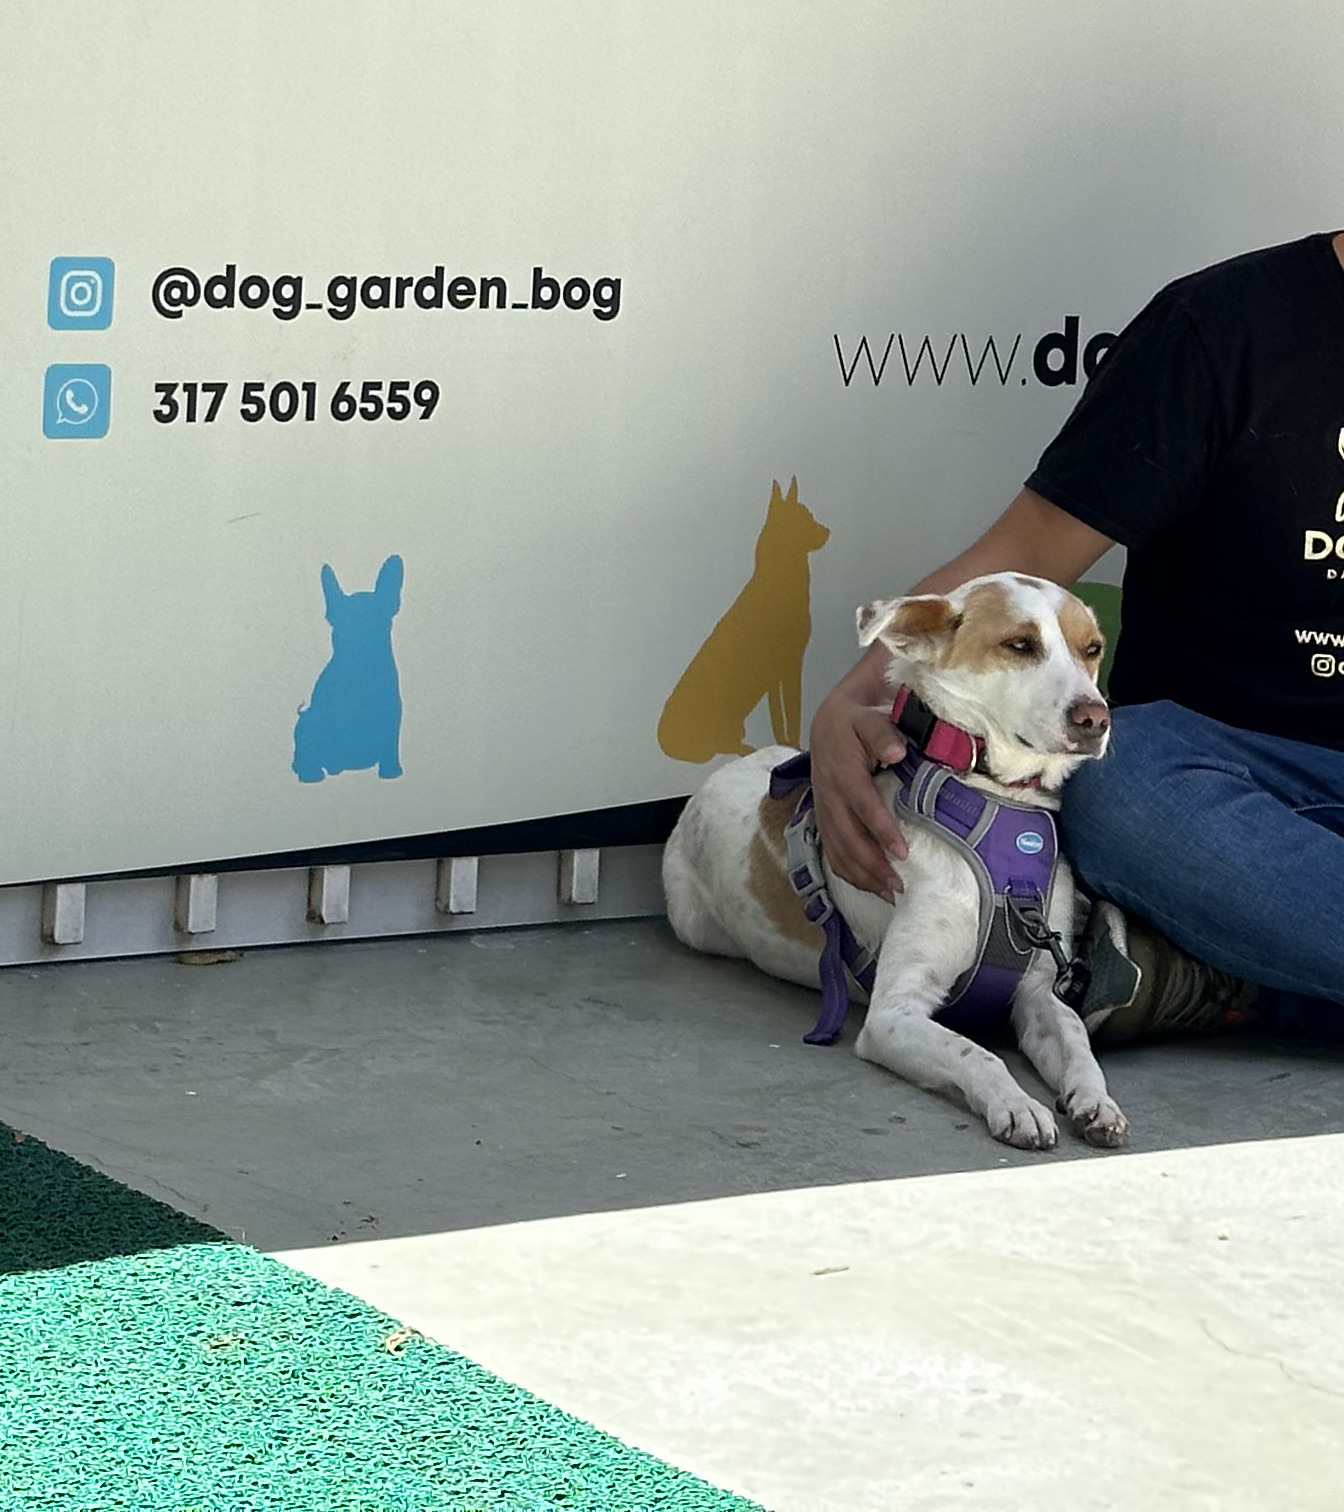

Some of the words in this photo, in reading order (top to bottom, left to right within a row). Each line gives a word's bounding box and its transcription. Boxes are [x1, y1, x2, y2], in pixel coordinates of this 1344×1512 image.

[152, 263, 622, 321] @dog_garden_bog
[152, 382, 228, 424] 317
[239, 381, 315, 423] 501
[330, 380, 440, 423] 6559
